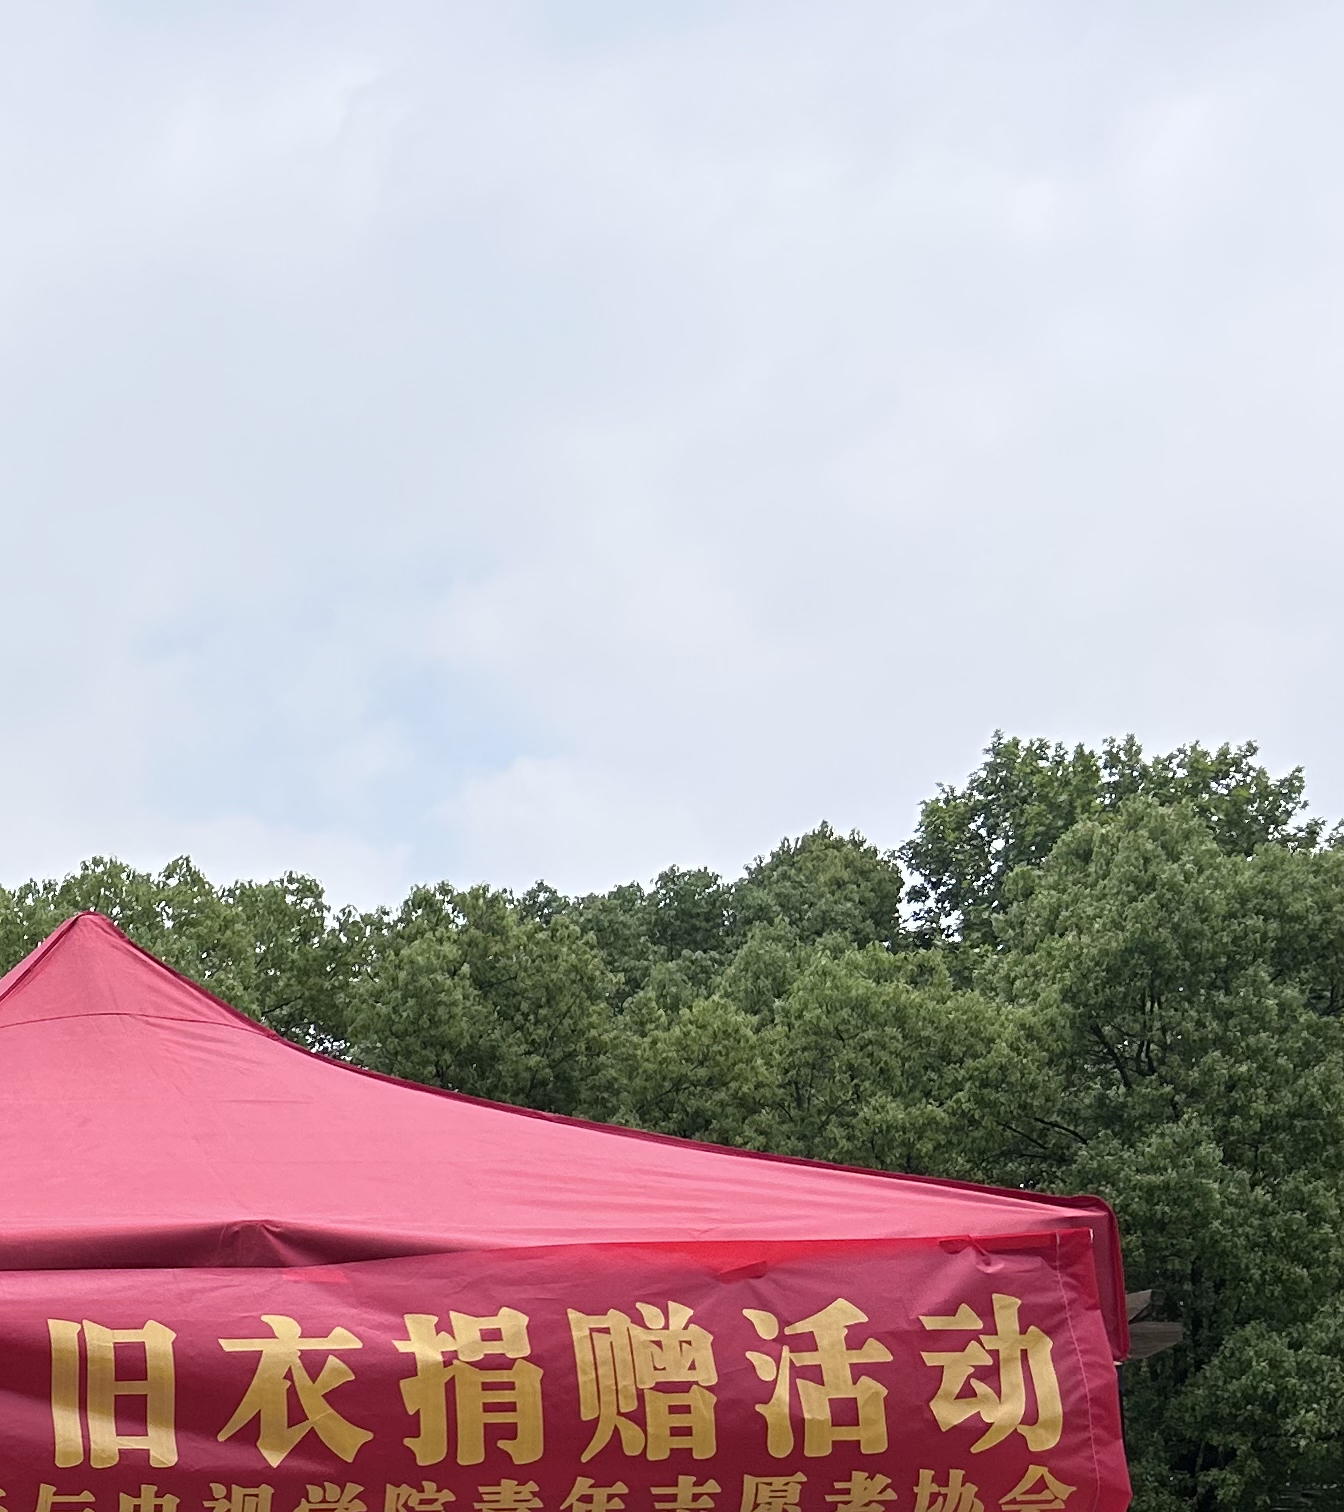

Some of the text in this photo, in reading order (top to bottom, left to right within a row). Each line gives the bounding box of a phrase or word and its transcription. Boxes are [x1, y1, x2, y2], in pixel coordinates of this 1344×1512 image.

[47, 1292, 1065, 1468] 旧衣捐赠活动
